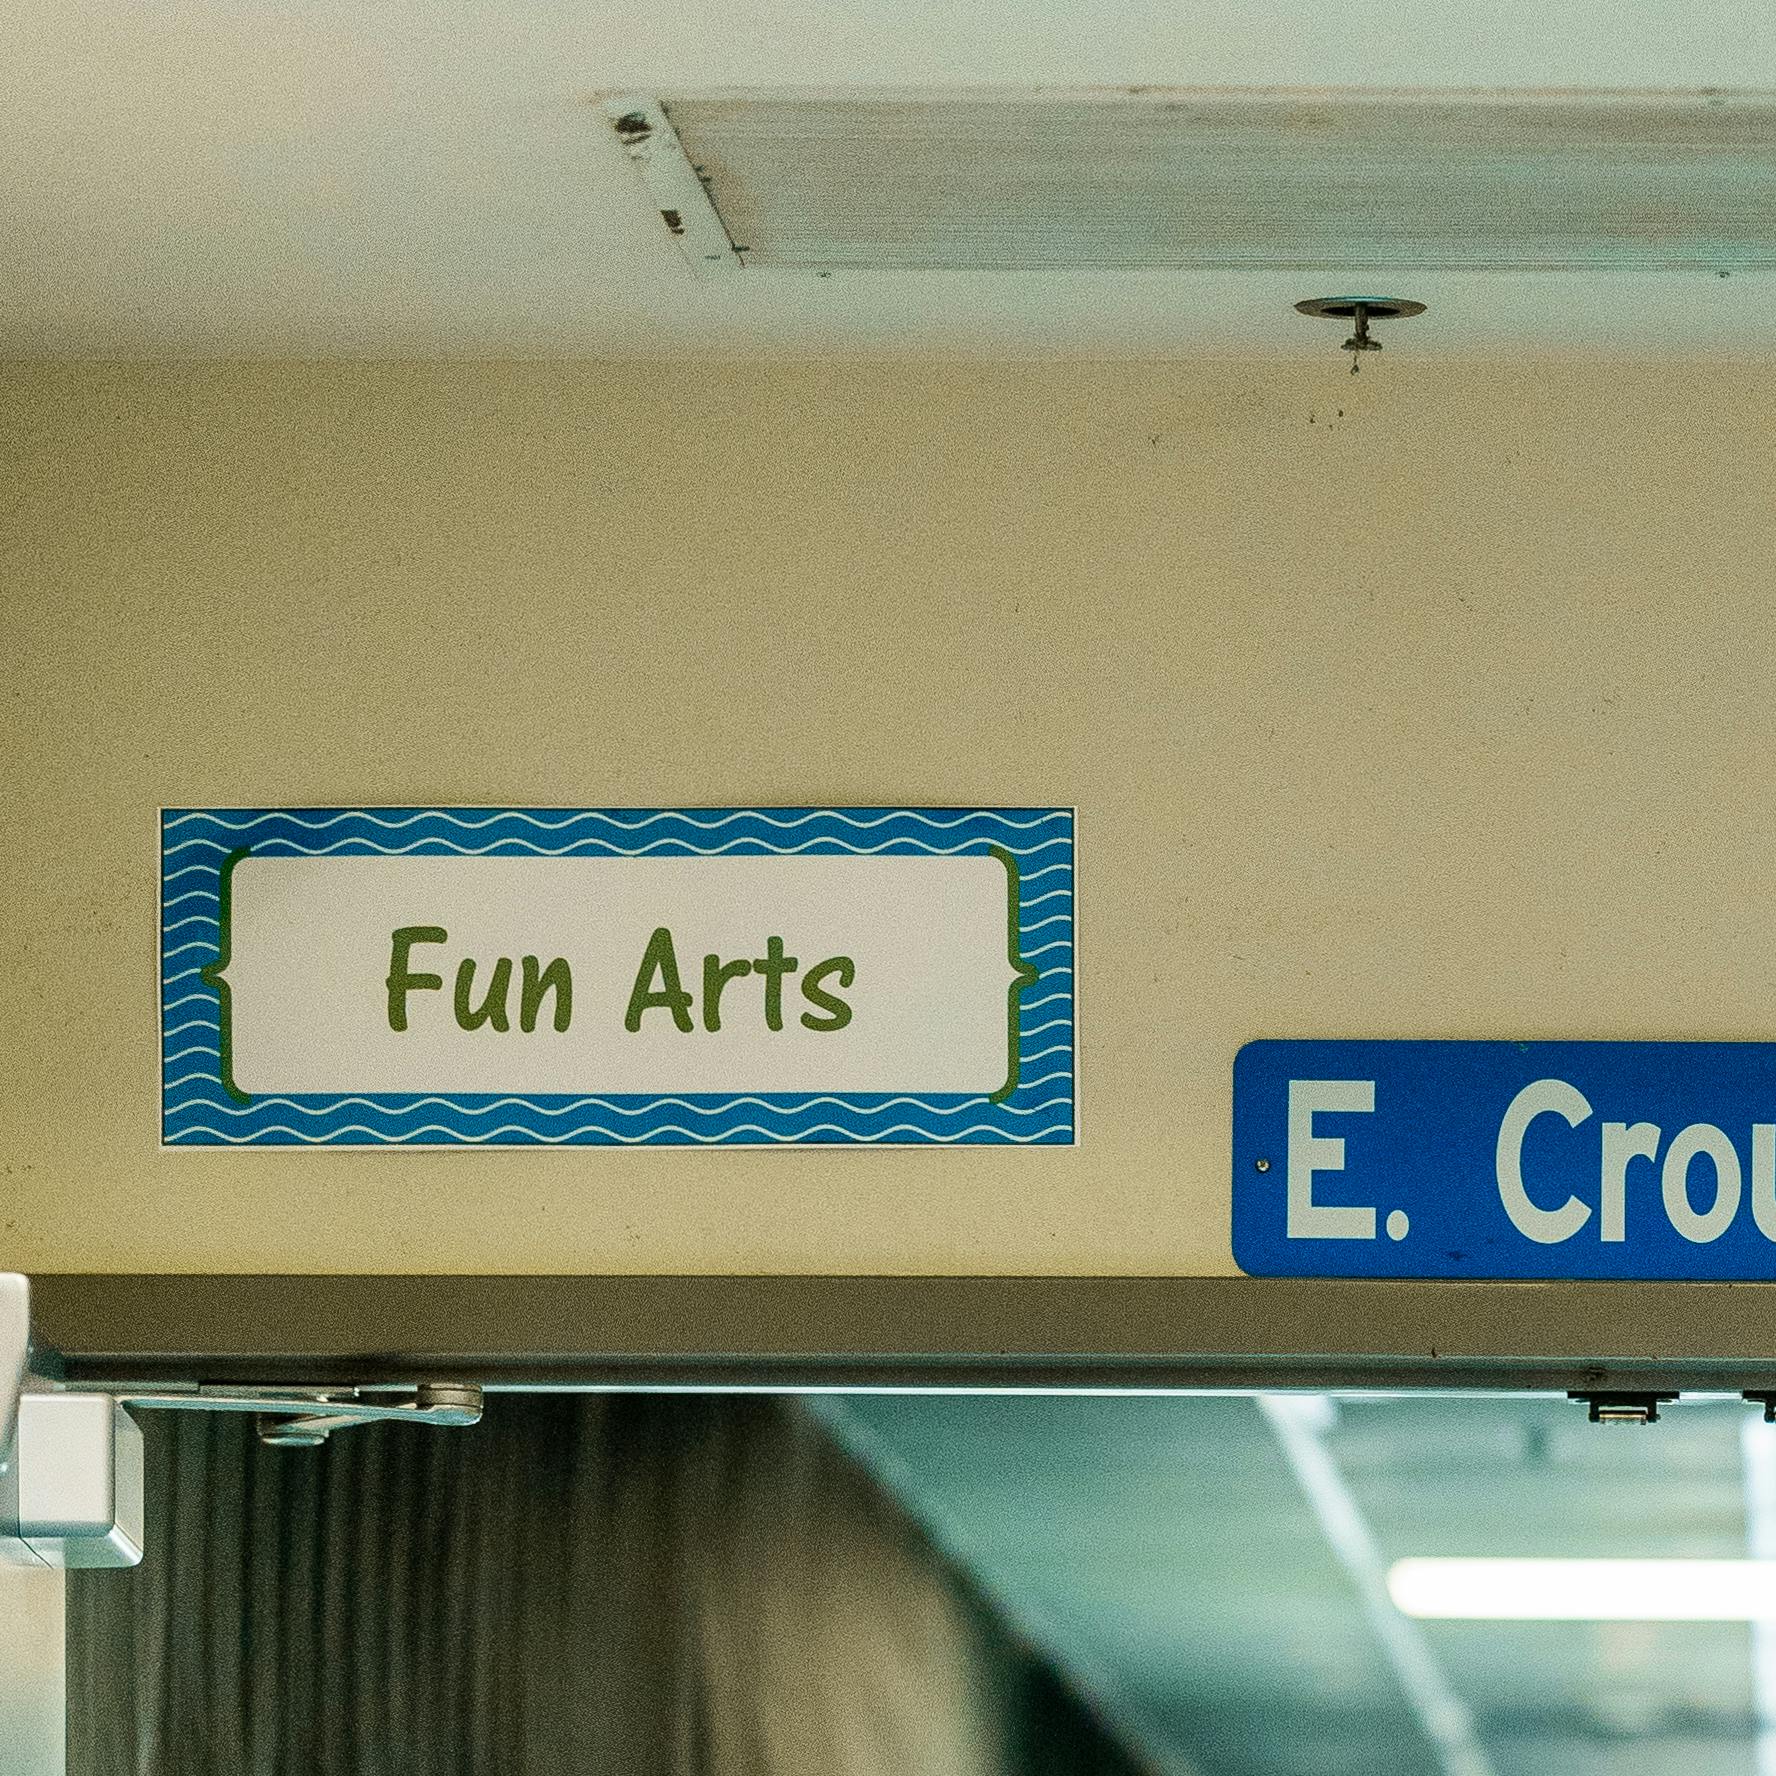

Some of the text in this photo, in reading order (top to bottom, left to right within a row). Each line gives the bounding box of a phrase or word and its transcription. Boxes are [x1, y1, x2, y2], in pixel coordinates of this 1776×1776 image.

[384, 924, 857, 1036] Fun Arts
[1286, 1079, 1410, 1242] E.
